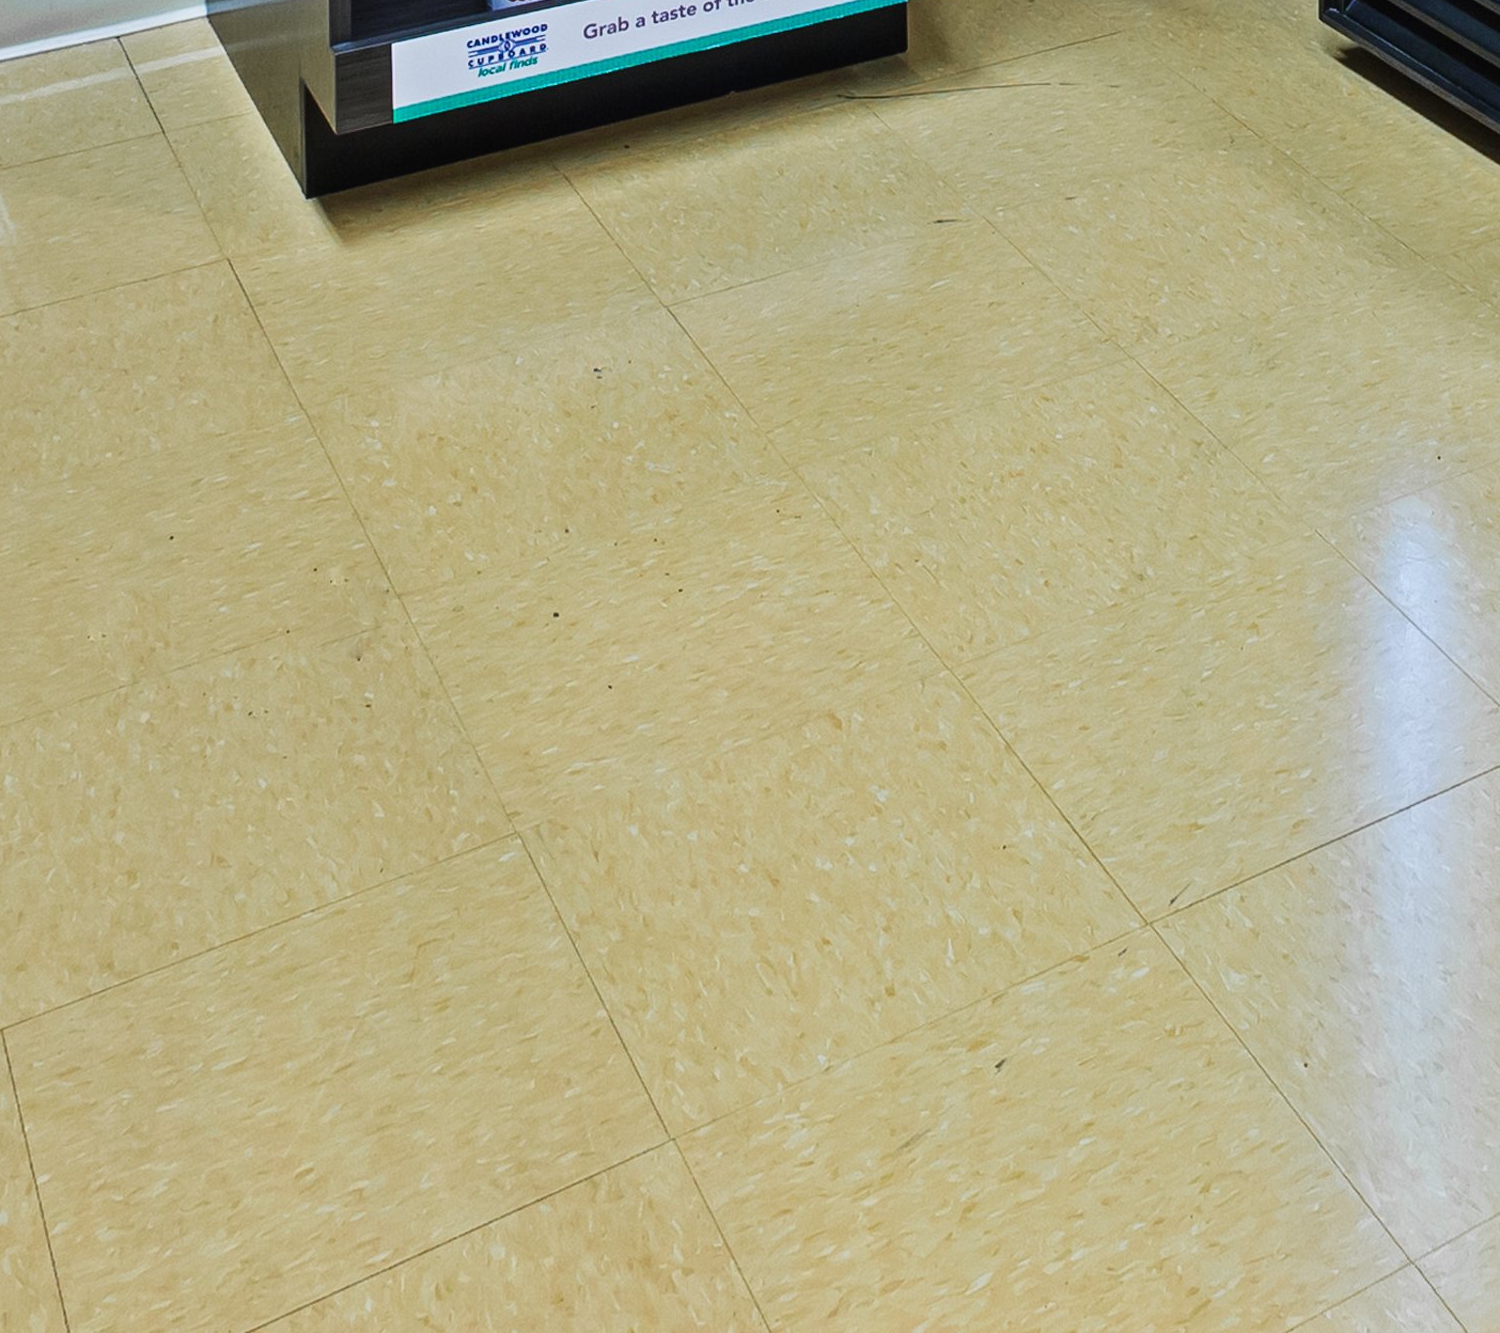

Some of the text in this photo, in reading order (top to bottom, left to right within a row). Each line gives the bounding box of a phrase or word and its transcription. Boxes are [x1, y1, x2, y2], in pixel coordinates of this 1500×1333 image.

[582, 16, 631, 40] Grab
[636, 16, 646, 28] a
[651, 4, 698, 25] taste
[466, 23, 549, 49] CANDLEWOOD
[467, 42, 548, 70] CUPBOARD
[477, 55, 540, 79] local finds
